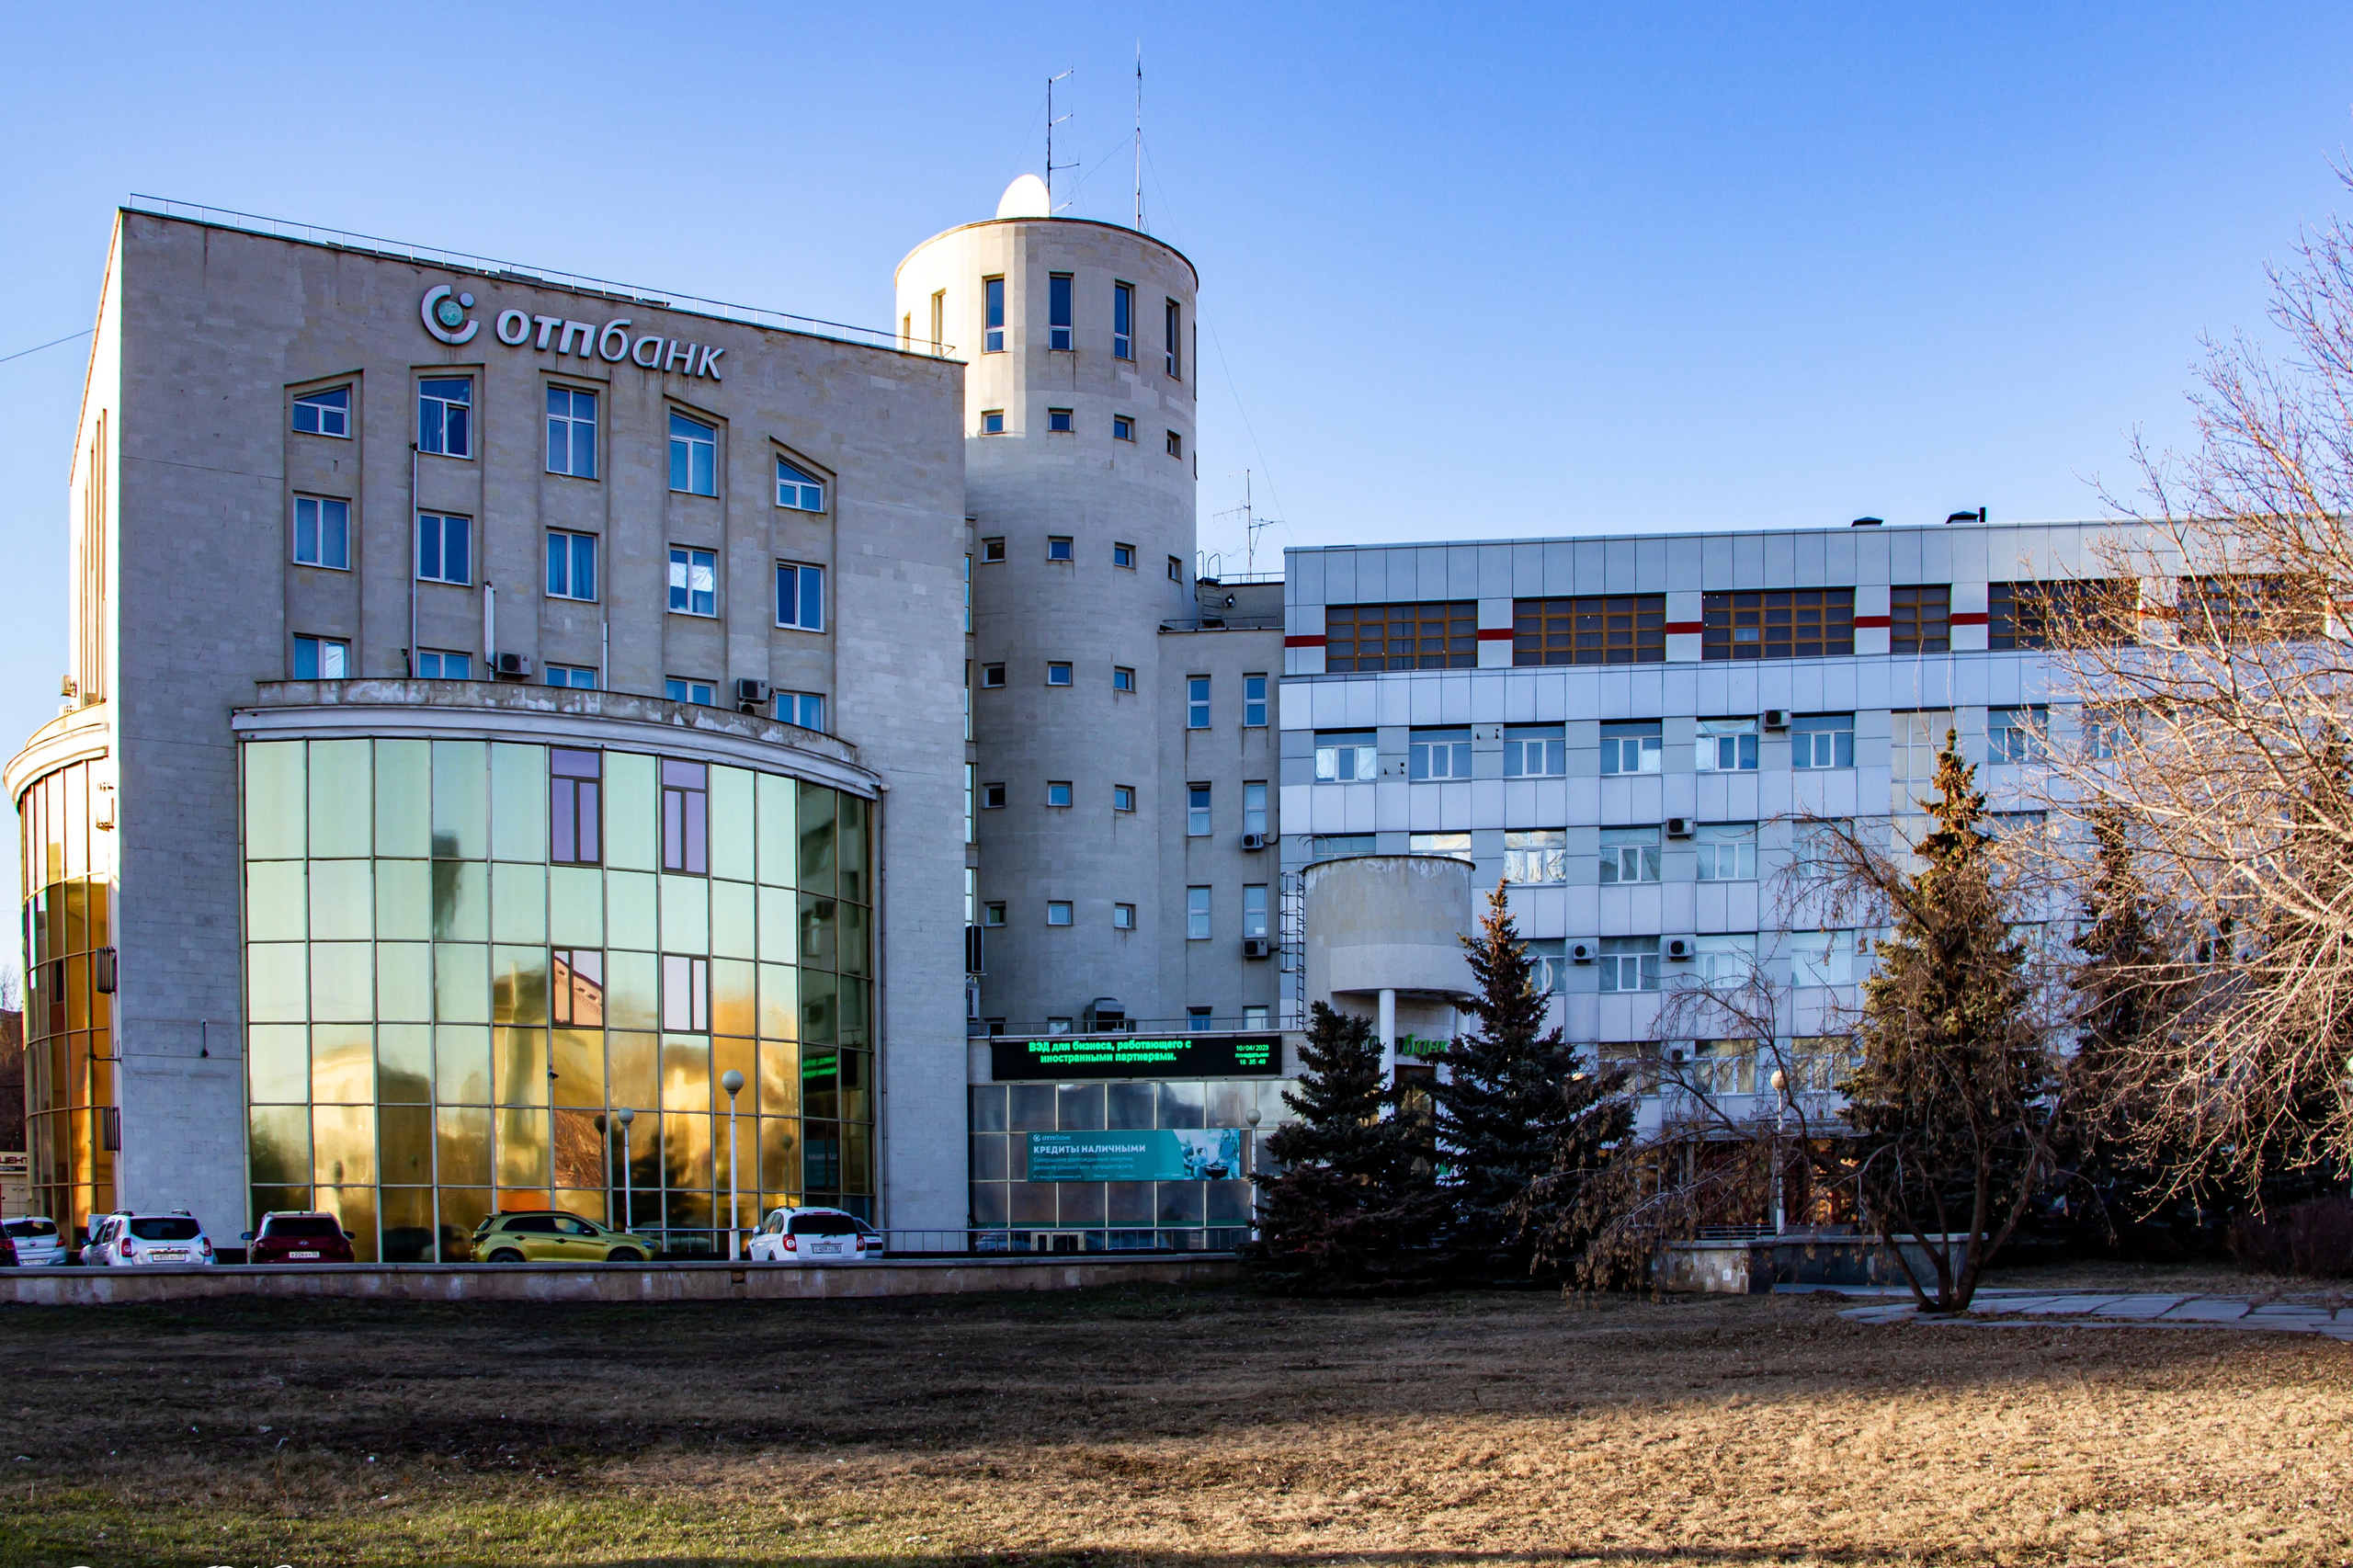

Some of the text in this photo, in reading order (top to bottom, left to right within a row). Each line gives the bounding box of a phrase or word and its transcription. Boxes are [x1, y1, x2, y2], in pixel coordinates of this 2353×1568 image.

[496, 309, 724, 381] отпбанк
[1028, 1040, 1192, 1052] ВЭД для бизнеса, работающего с
[1040, 1052, 1177, 1064] иностранными партнерами.
[1033, 1144, 1146, 1154] КРЕДИТЫ НАЛИЧНЫМИ
